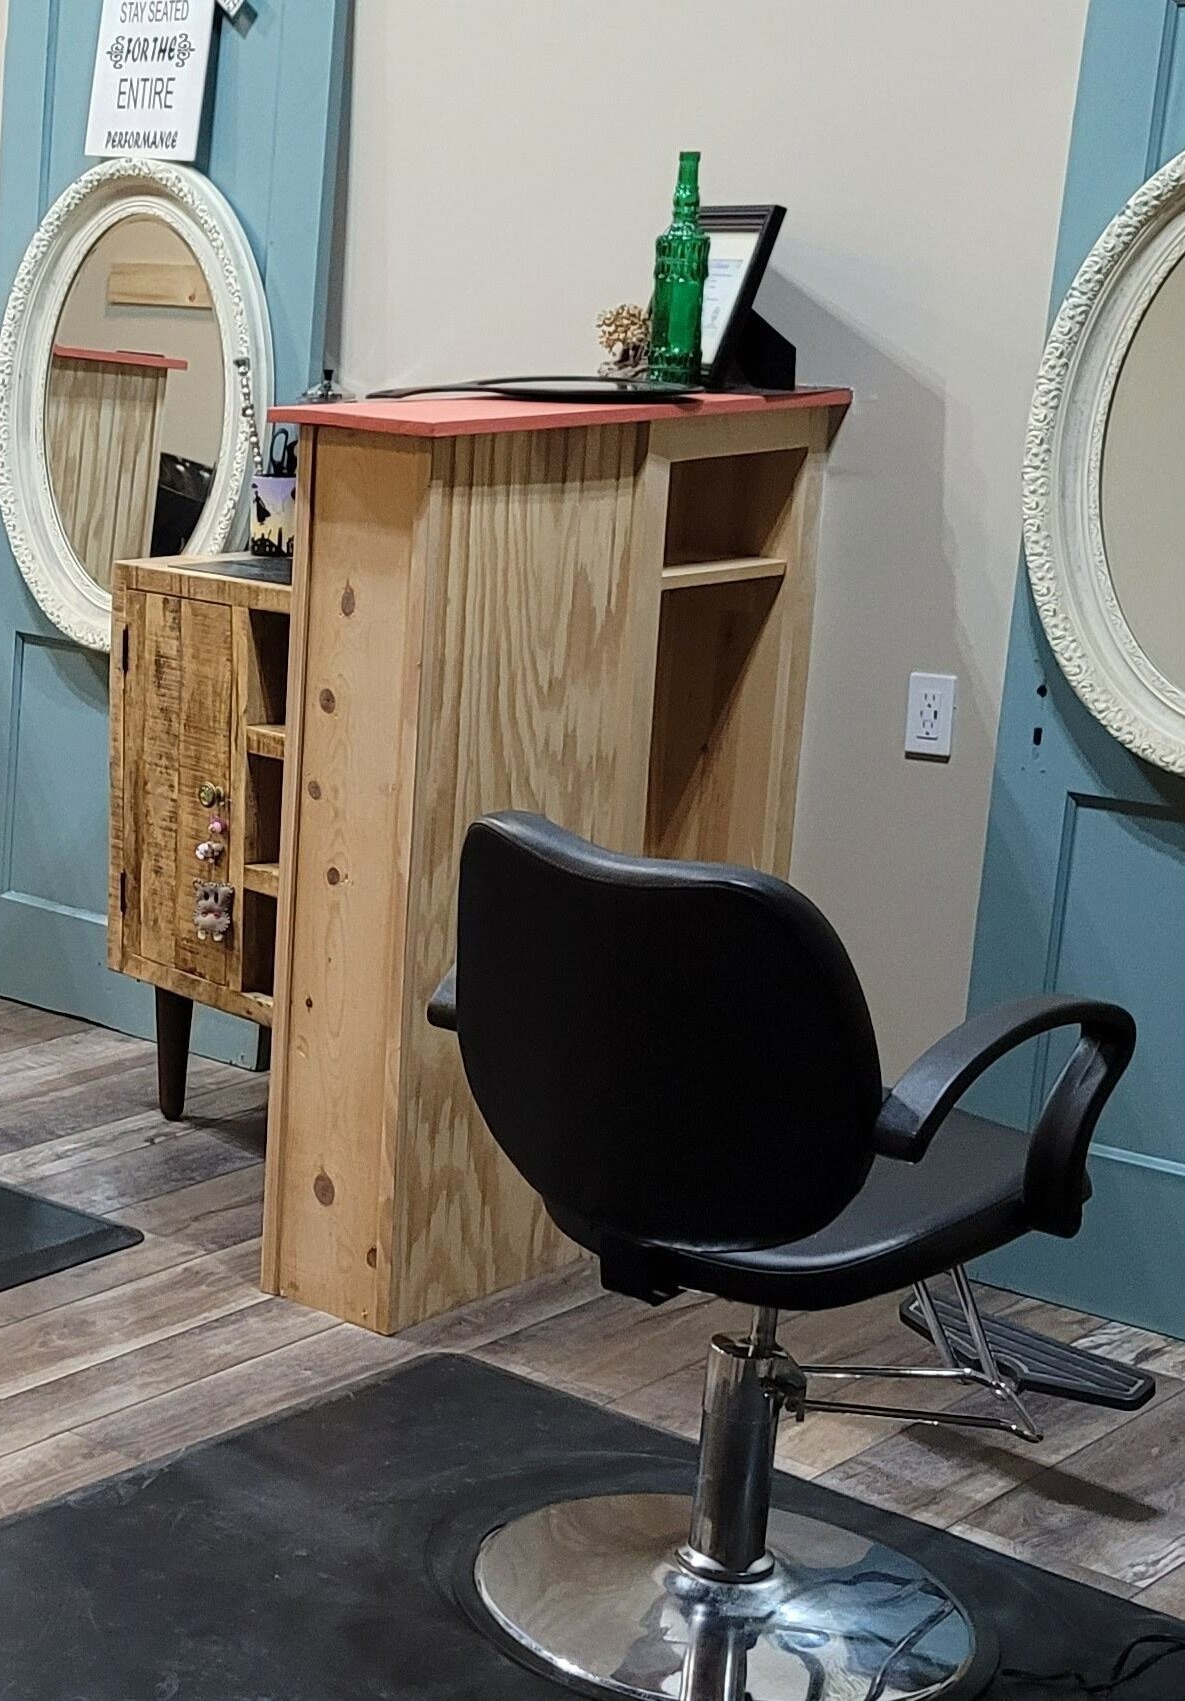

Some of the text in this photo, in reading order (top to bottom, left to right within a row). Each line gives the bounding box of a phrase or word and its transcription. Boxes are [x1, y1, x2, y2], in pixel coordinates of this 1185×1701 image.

[120, 0, 190, 23] STAY SEATED
[124, 35, 177, 63] FOR THE
[117, 77, 176, 109] ENTIRE
[105, 130, 178, 149] PERFORMANCE
